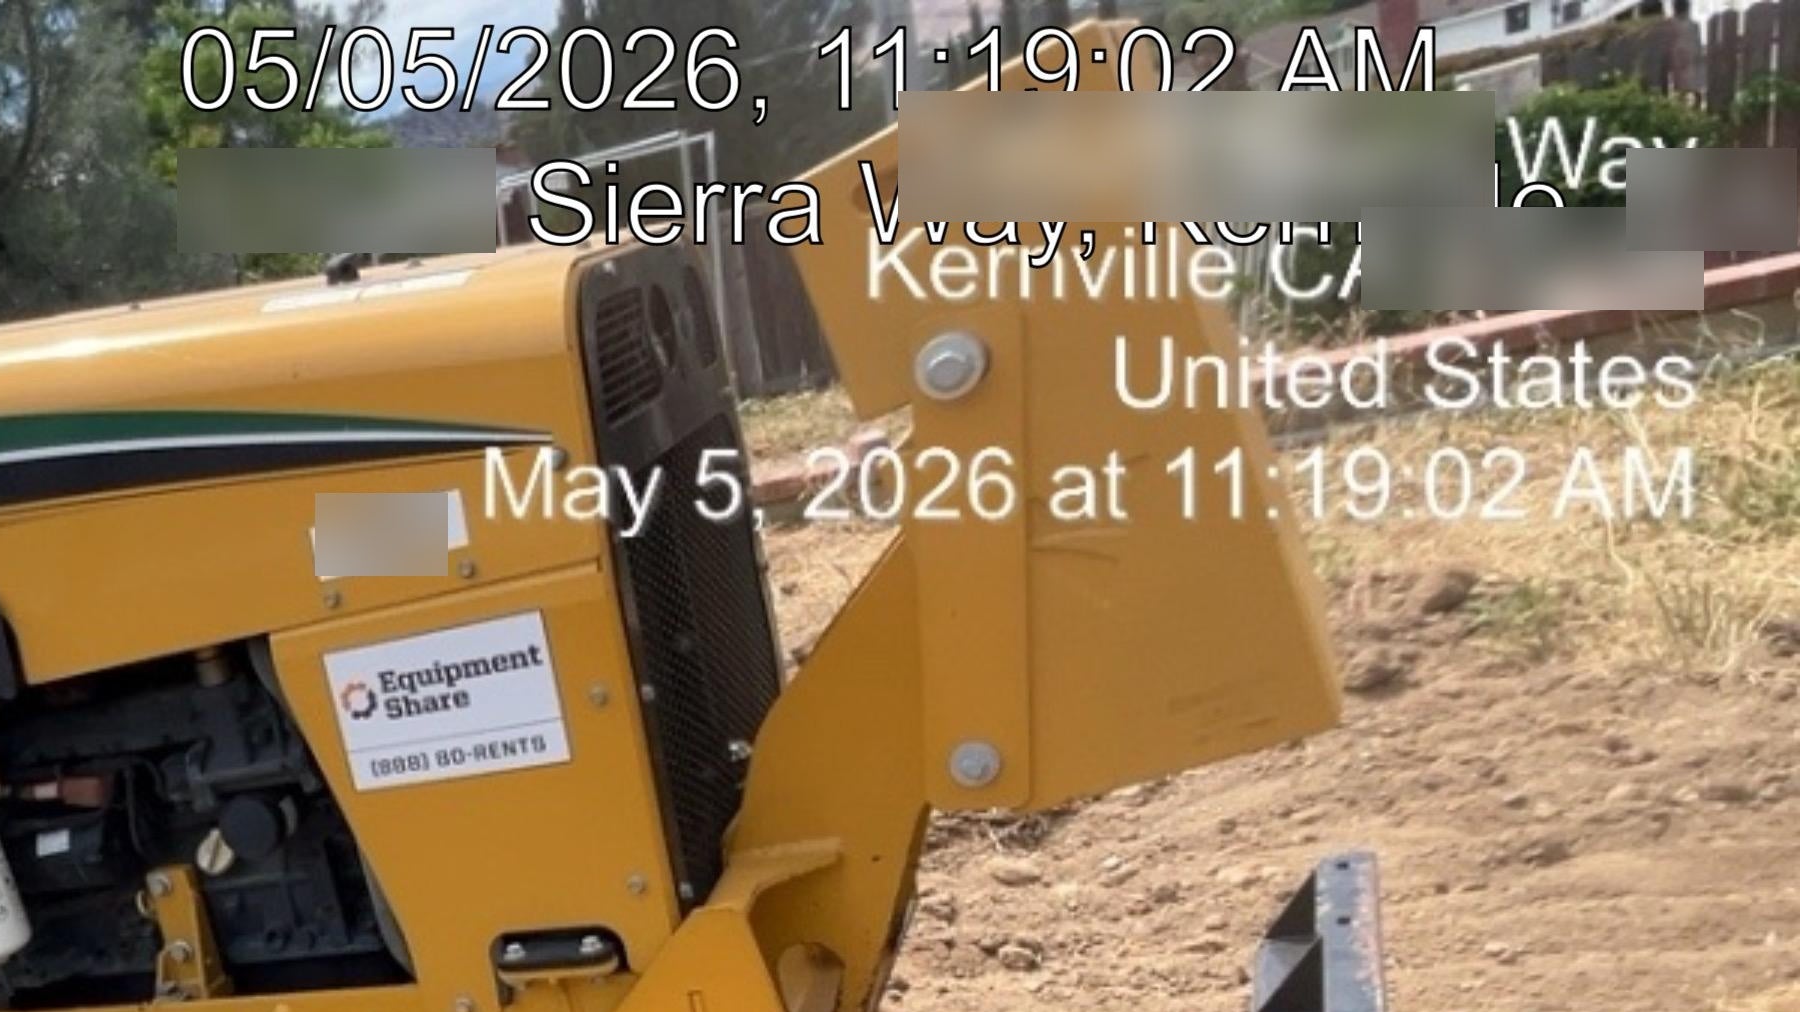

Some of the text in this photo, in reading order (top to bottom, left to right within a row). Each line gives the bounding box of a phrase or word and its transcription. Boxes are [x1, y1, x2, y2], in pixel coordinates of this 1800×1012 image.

[377, 644, 543, 694] Equipment
[383, 689, 471, 721] Share
[370, 734, 548, 778] (888) 80-RENTS
